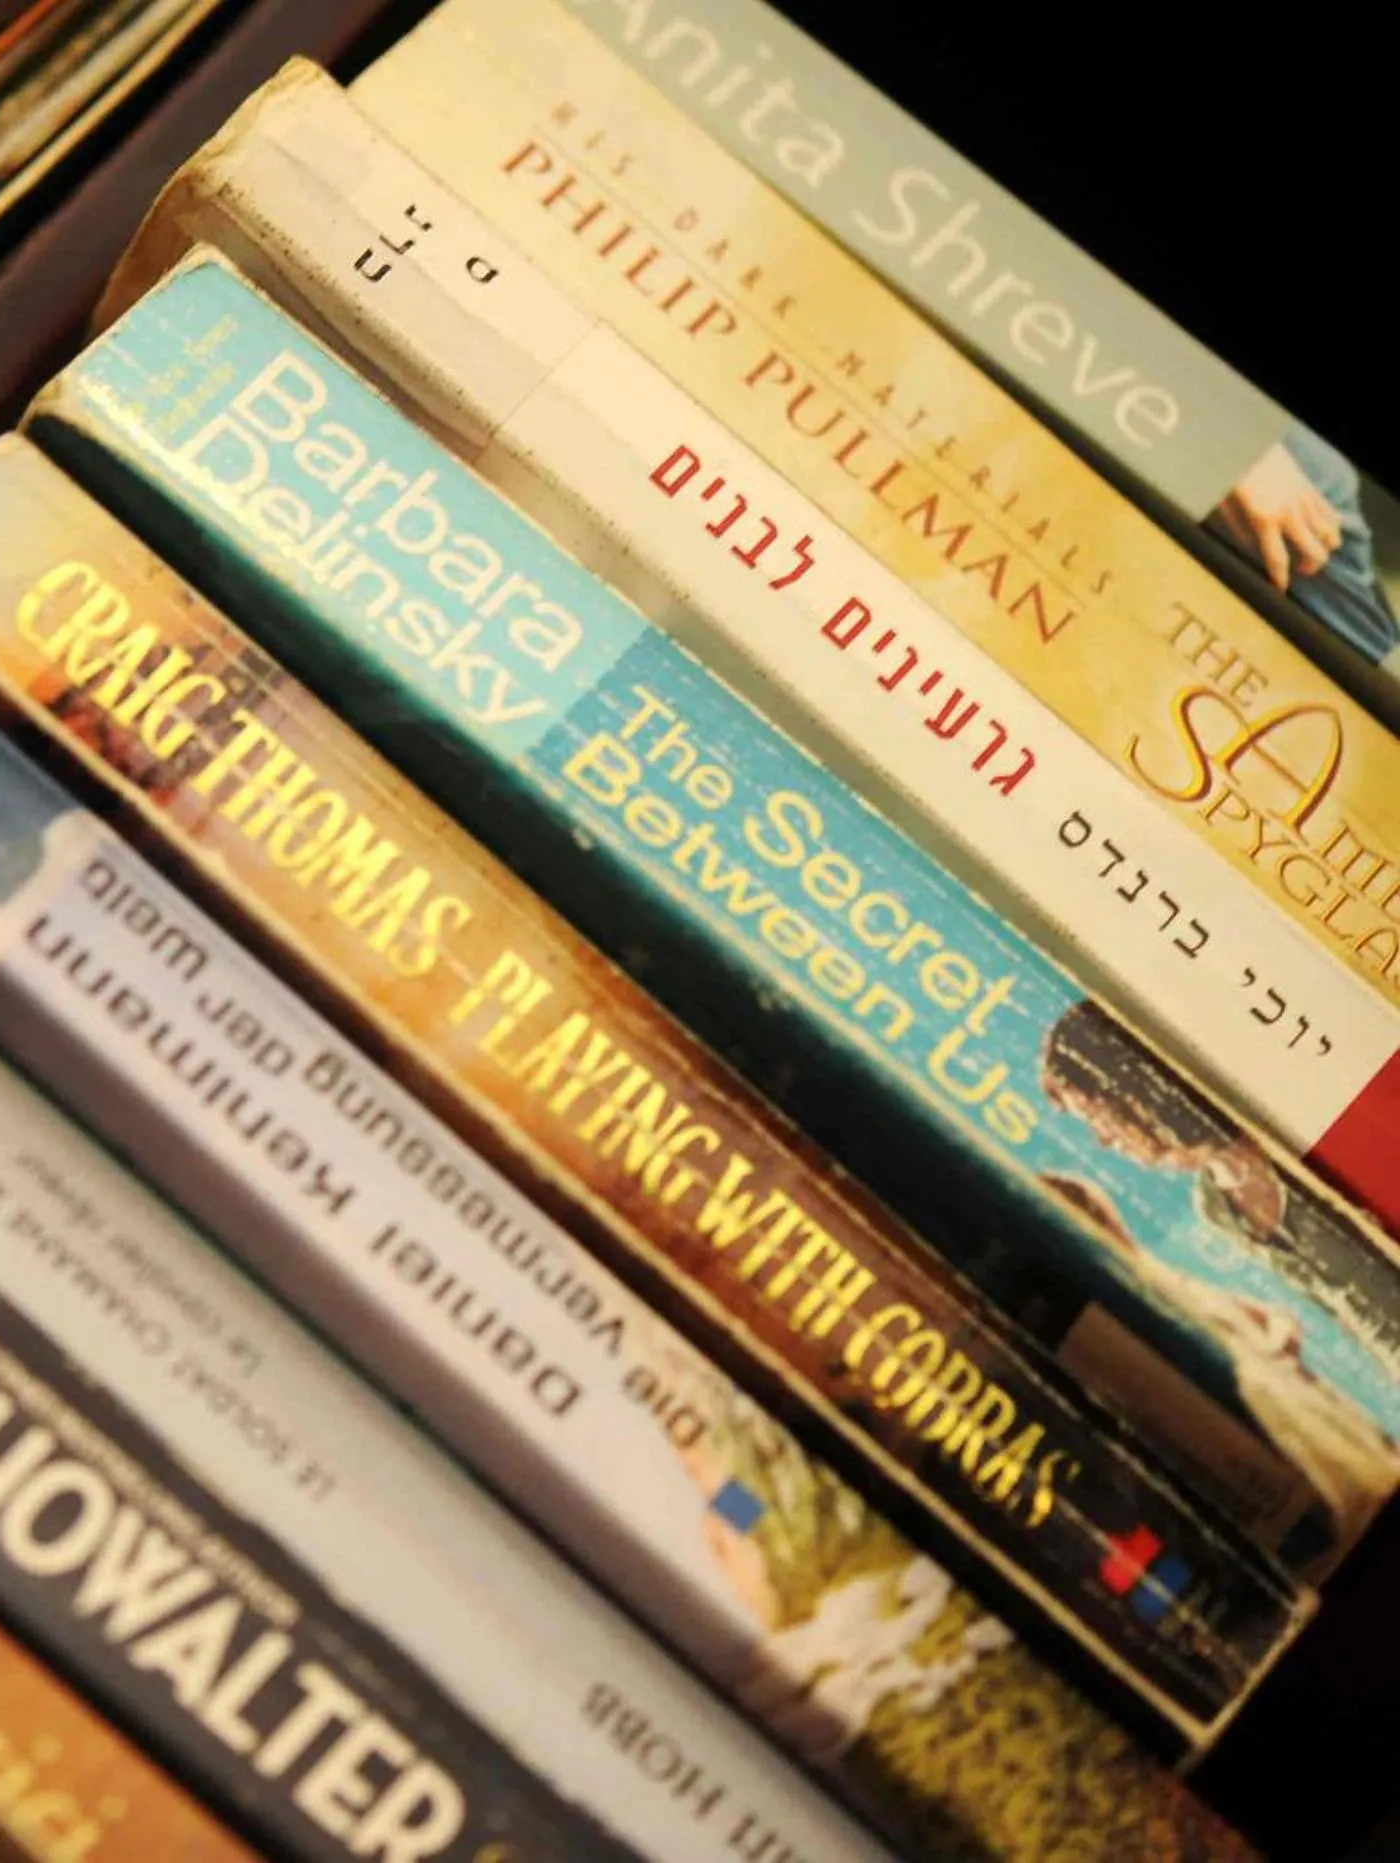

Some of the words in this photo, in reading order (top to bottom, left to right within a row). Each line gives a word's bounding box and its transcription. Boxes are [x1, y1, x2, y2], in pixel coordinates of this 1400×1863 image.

[550, 101, 634, 178] HIS
[673, 208, 803, 321] DARK
[835, 352, 1119, 595] MATERIALS
[618, 0, 846, 188] nita
[851, 168, 1180, 449] Shreve
[233, 349, 584, 671] Barbara
[502, 139, 738, 338] PHILIP
[743, 350, 1079, 647] PULLMAN
[648, 444, 815, 590] לבנים
[174, 412, 546, 725] Delinsky
[820, 596, 1036, 797] גרעינים
[1160, 602, 1269, 709] THE
[15, 560, 226, 760] CRAIG
[192, 707, 473, 976] THOMAS
[619, 685, 734, 811] The
[743, 790, 1018, 1037] Secret
[1058, 810, 1210, 959] ברנדס
[1122, 683, 1400, 992] SPYGLA
[24, 914, 357, 1216] Kehlmann
[195, 992, 295, 1077] der
[562, 731, 915, 1042] Between
[927, 1029, 1040, 1144] Us
[1241, 967, 1332, 1056] יוכי
[367, 1223, 584, 1418] Daniel
[447, 950, 721, 1207] PLAYING
[695, 1150, 876, 1342] WITH
[841, 1302, 1082, 1529] COBRAS
[620, 1367, 708, 1450] Die
[579, 1679, 726, 1823] HOBB
